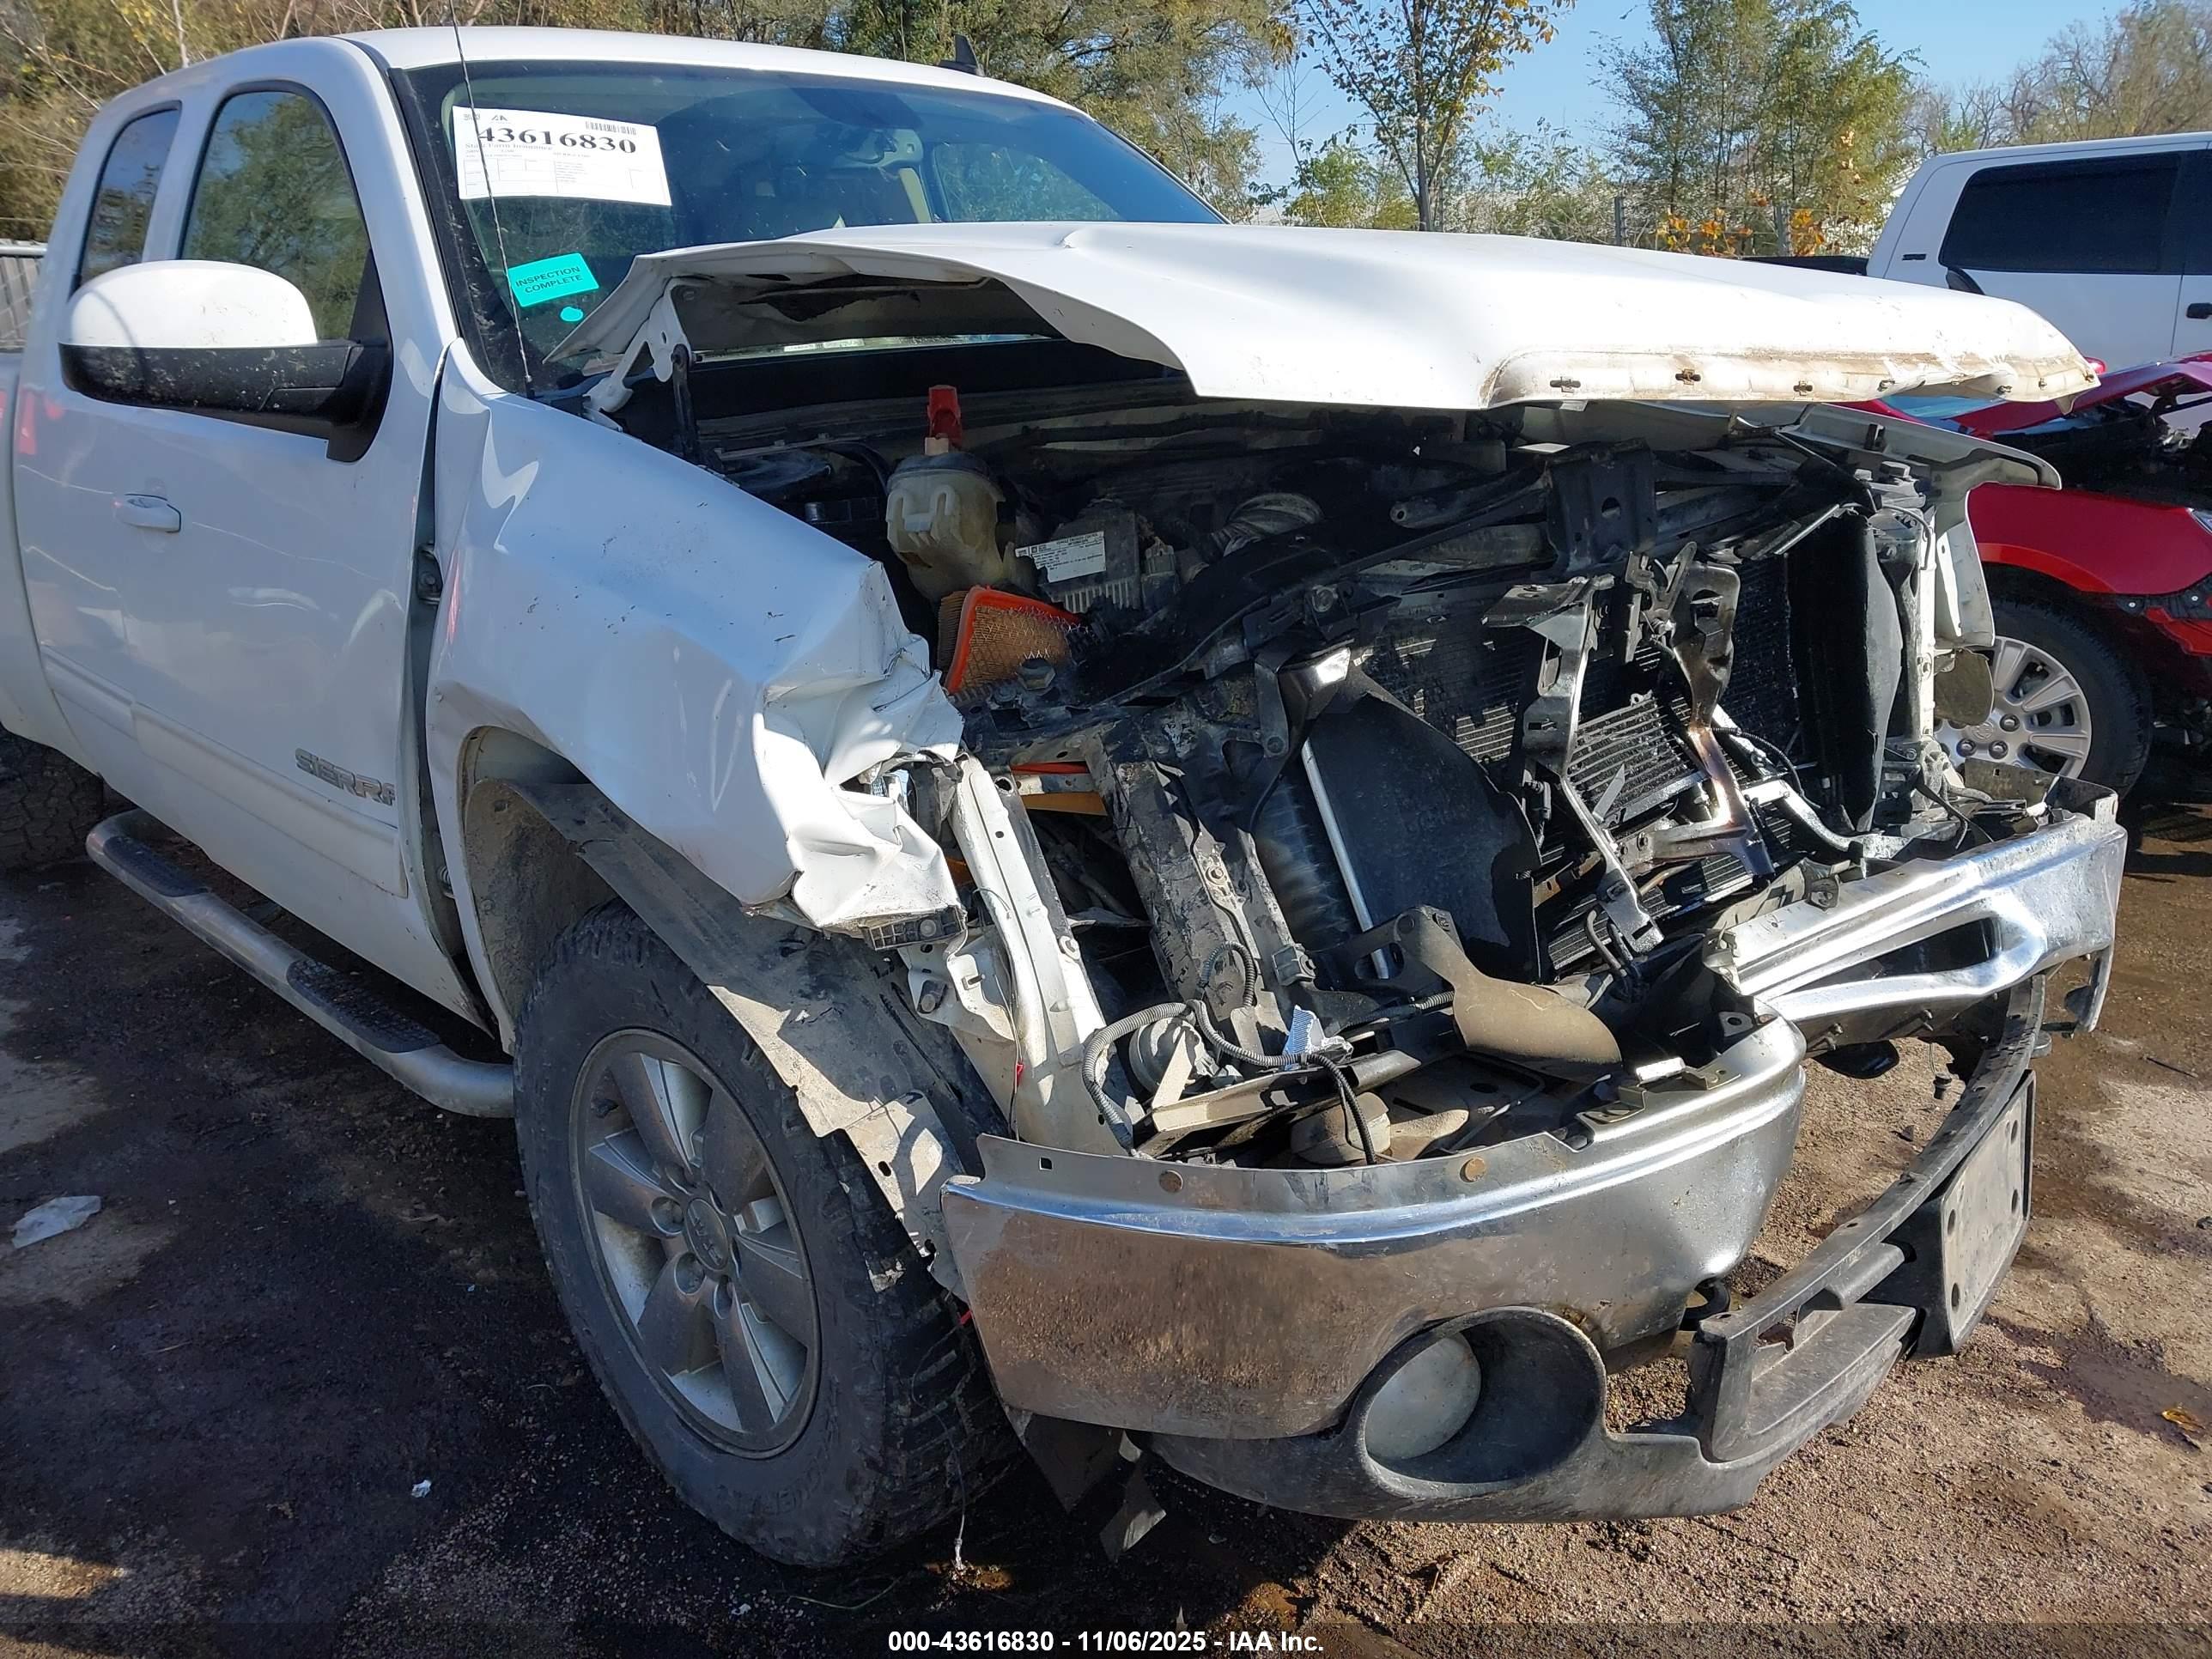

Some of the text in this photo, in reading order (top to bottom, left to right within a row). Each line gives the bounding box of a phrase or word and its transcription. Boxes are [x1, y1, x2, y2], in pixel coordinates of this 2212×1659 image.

[477, 126, 636, 154] 43616830
[515, 266, 580, 287] INSPECTION
[525, 275, 583, 294] COMPLETE
